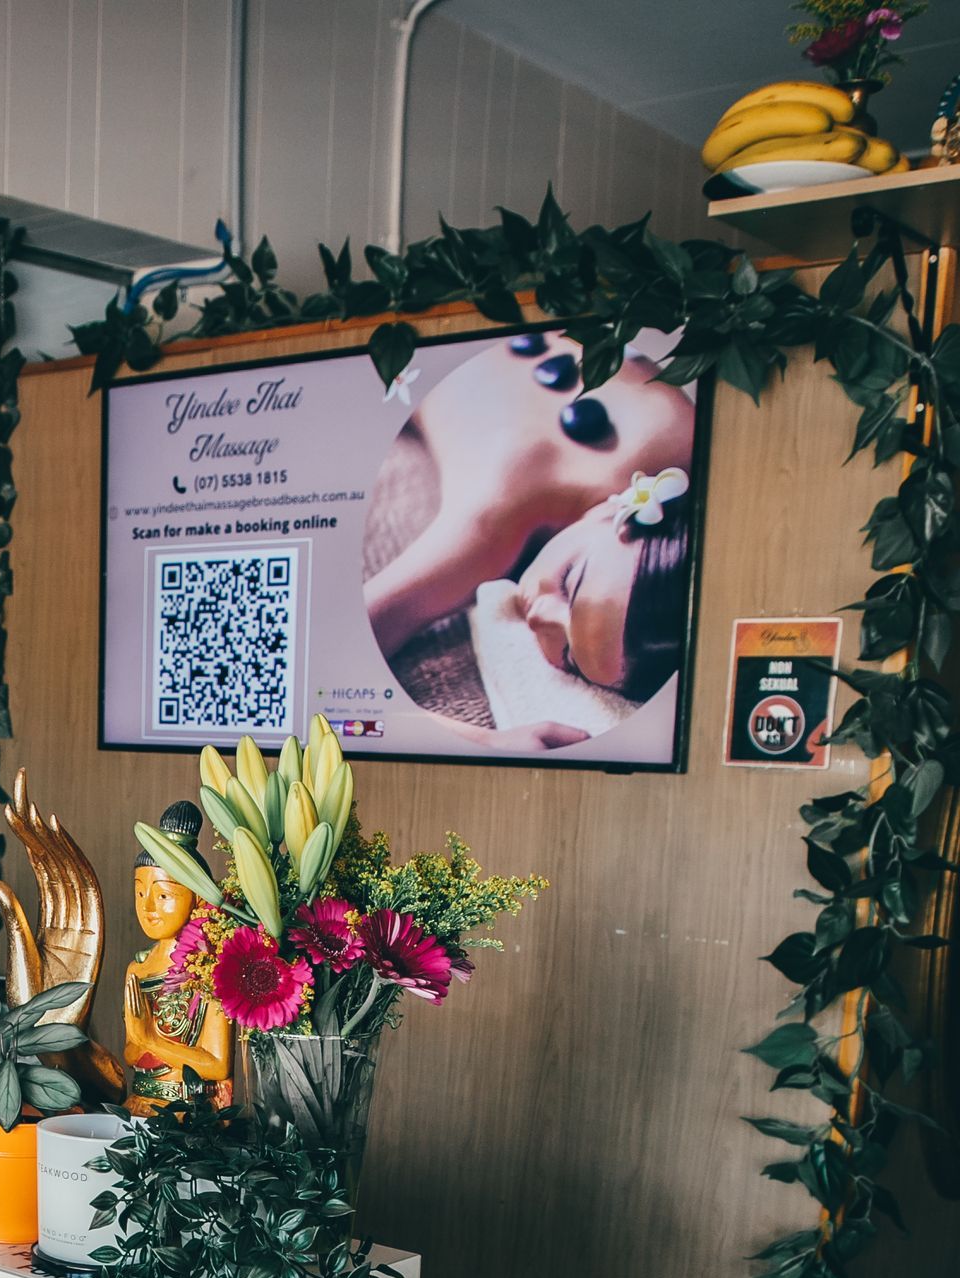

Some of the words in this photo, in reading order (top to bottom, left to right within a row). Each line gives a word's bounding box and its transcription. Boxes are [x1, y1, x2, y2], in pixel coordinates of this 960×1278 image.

[165, 387, 241, 434] Yindee
[246, 377, 303, 415] Thai
[189, 433, 280, 466] Massage
[194, 473, 219, 494] (07)
[222, 472, 253, 488] 5538
[257, 469, 288, 484] 1815
[132, 527, 161, 540] Scan
[164, 524, 182, 538] for
[185, 522, 221, 537] make
[224, 523, 232, 534] a
[235, 517, 290, 535] booking
[293, 514, 338, 530] online
[768, 661, 793, 674] NON
[332, 688, 376, 700] HICAPS
[759, 677, 799, 691] SEXUAL
